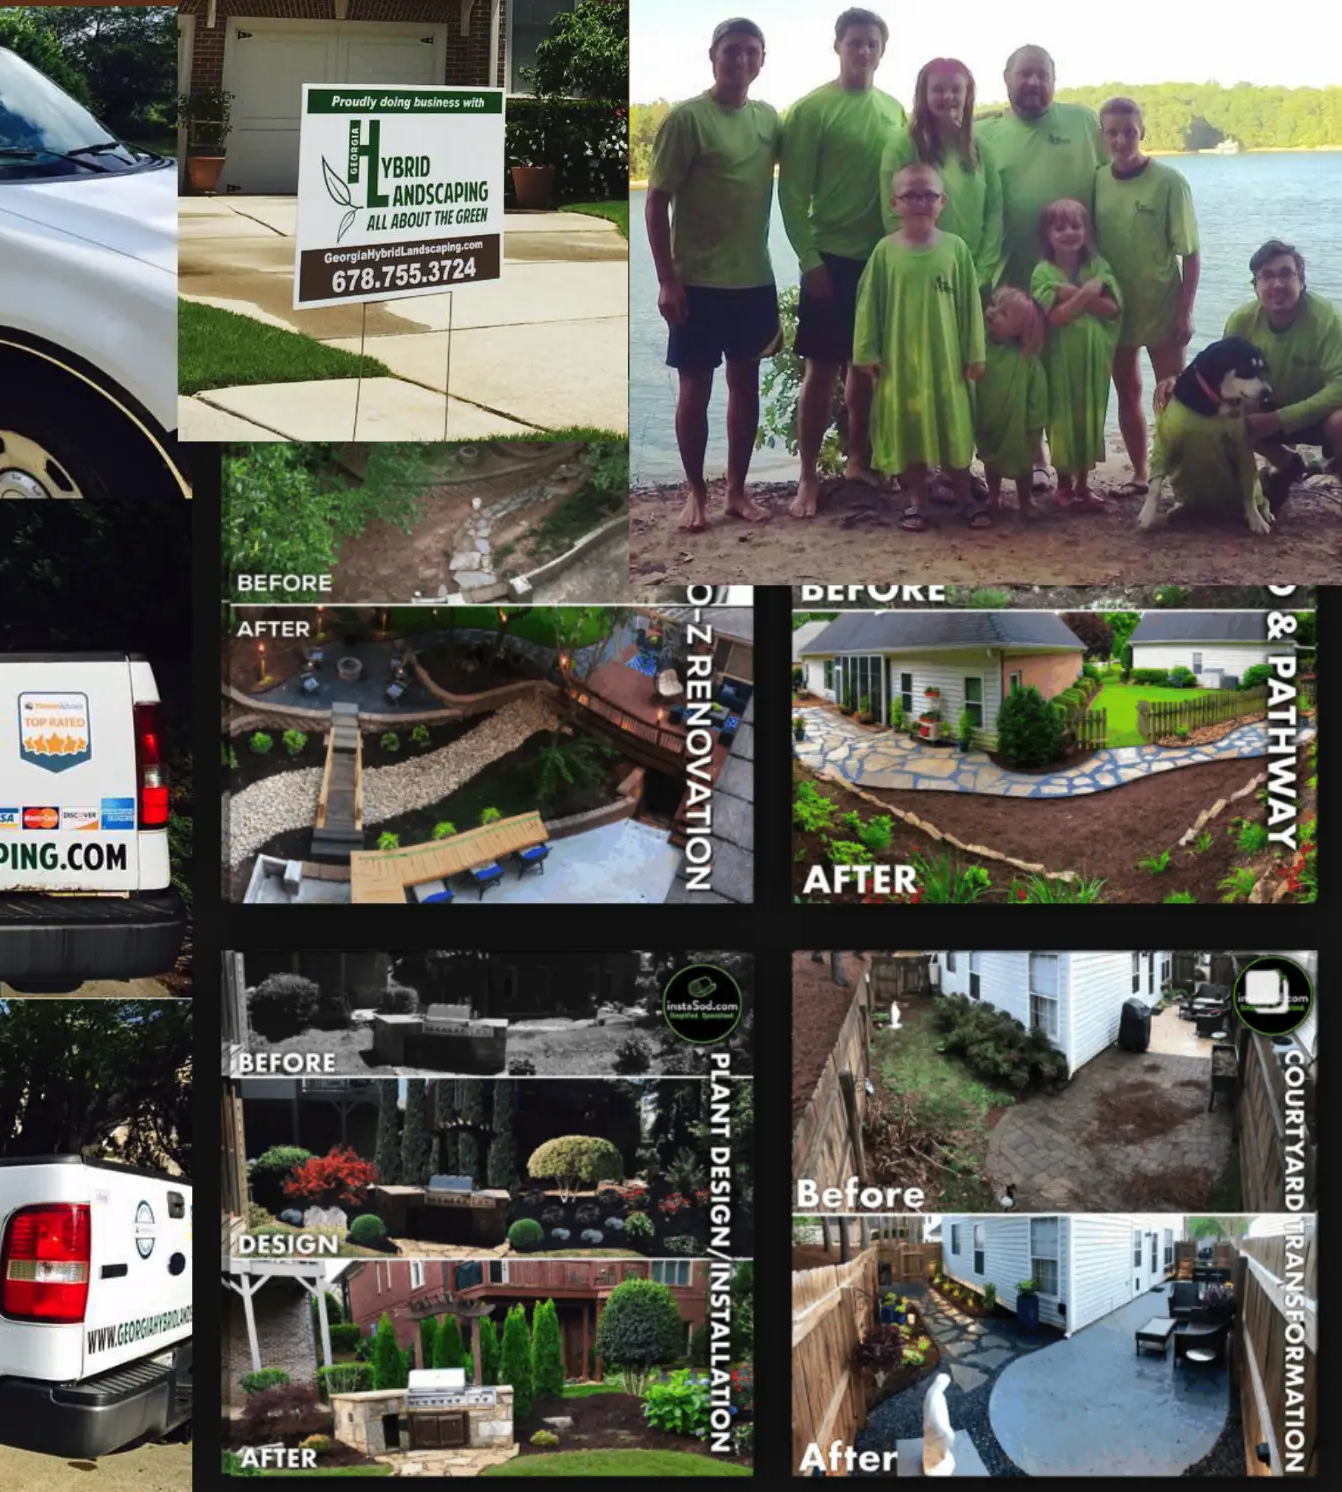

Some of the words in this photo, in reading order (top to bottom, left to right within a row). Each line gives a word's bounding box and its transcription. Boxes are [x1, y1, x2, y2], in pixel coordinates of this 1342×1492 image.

[331, 95, 378, 110] Proudly
[379, 95, 411, 110] doing
[413, 96, 460, 109] business
[463, 97, 485, 109] with
[350, 127, 360, 175] GEORGIA
[366, 214, 388, 231] ALL
[390, 211, 432, 229] ABOUT
[434, 209, 454, 225] THE
[455, 207, 488, 225] GREEN
[324, 240, 484, 264] GeorgiaHybridLandscaping.com
[331, 256, 477, 293] 678.755.3724
[24, 716, 47, 728] TOP
[49, 717, 86, 729] RATED
